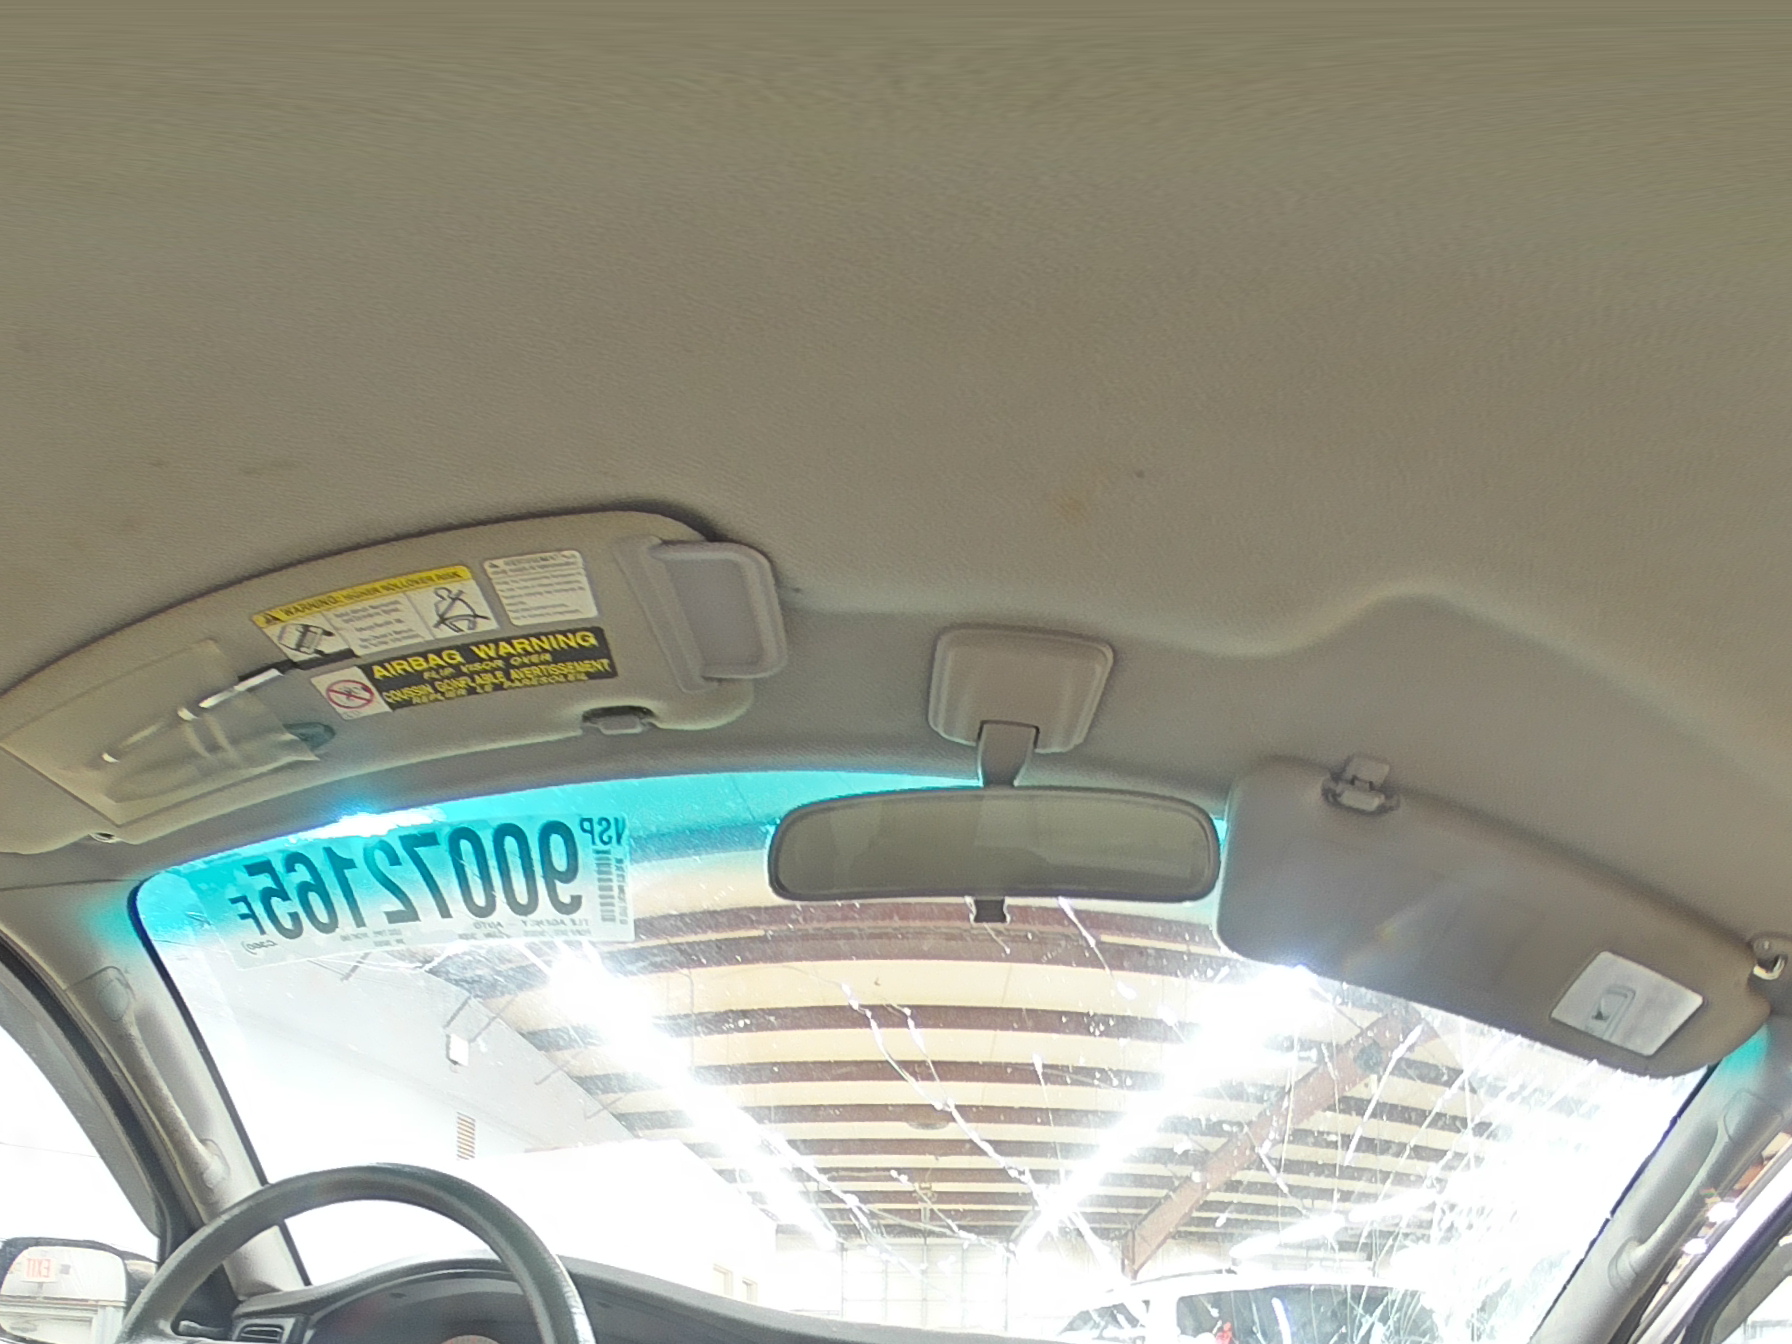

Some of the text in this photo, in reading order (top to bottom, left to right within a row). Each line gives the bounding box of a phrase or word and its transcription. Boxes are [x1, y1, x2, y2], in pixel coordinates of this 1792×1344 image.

[370, 631, 599, 680] AIRBAG WARNING
[460, 659, 506, 675] VISOR
[510, 653, 552, 667] OVER
[382, 683, 433, 704] COUSSIN
